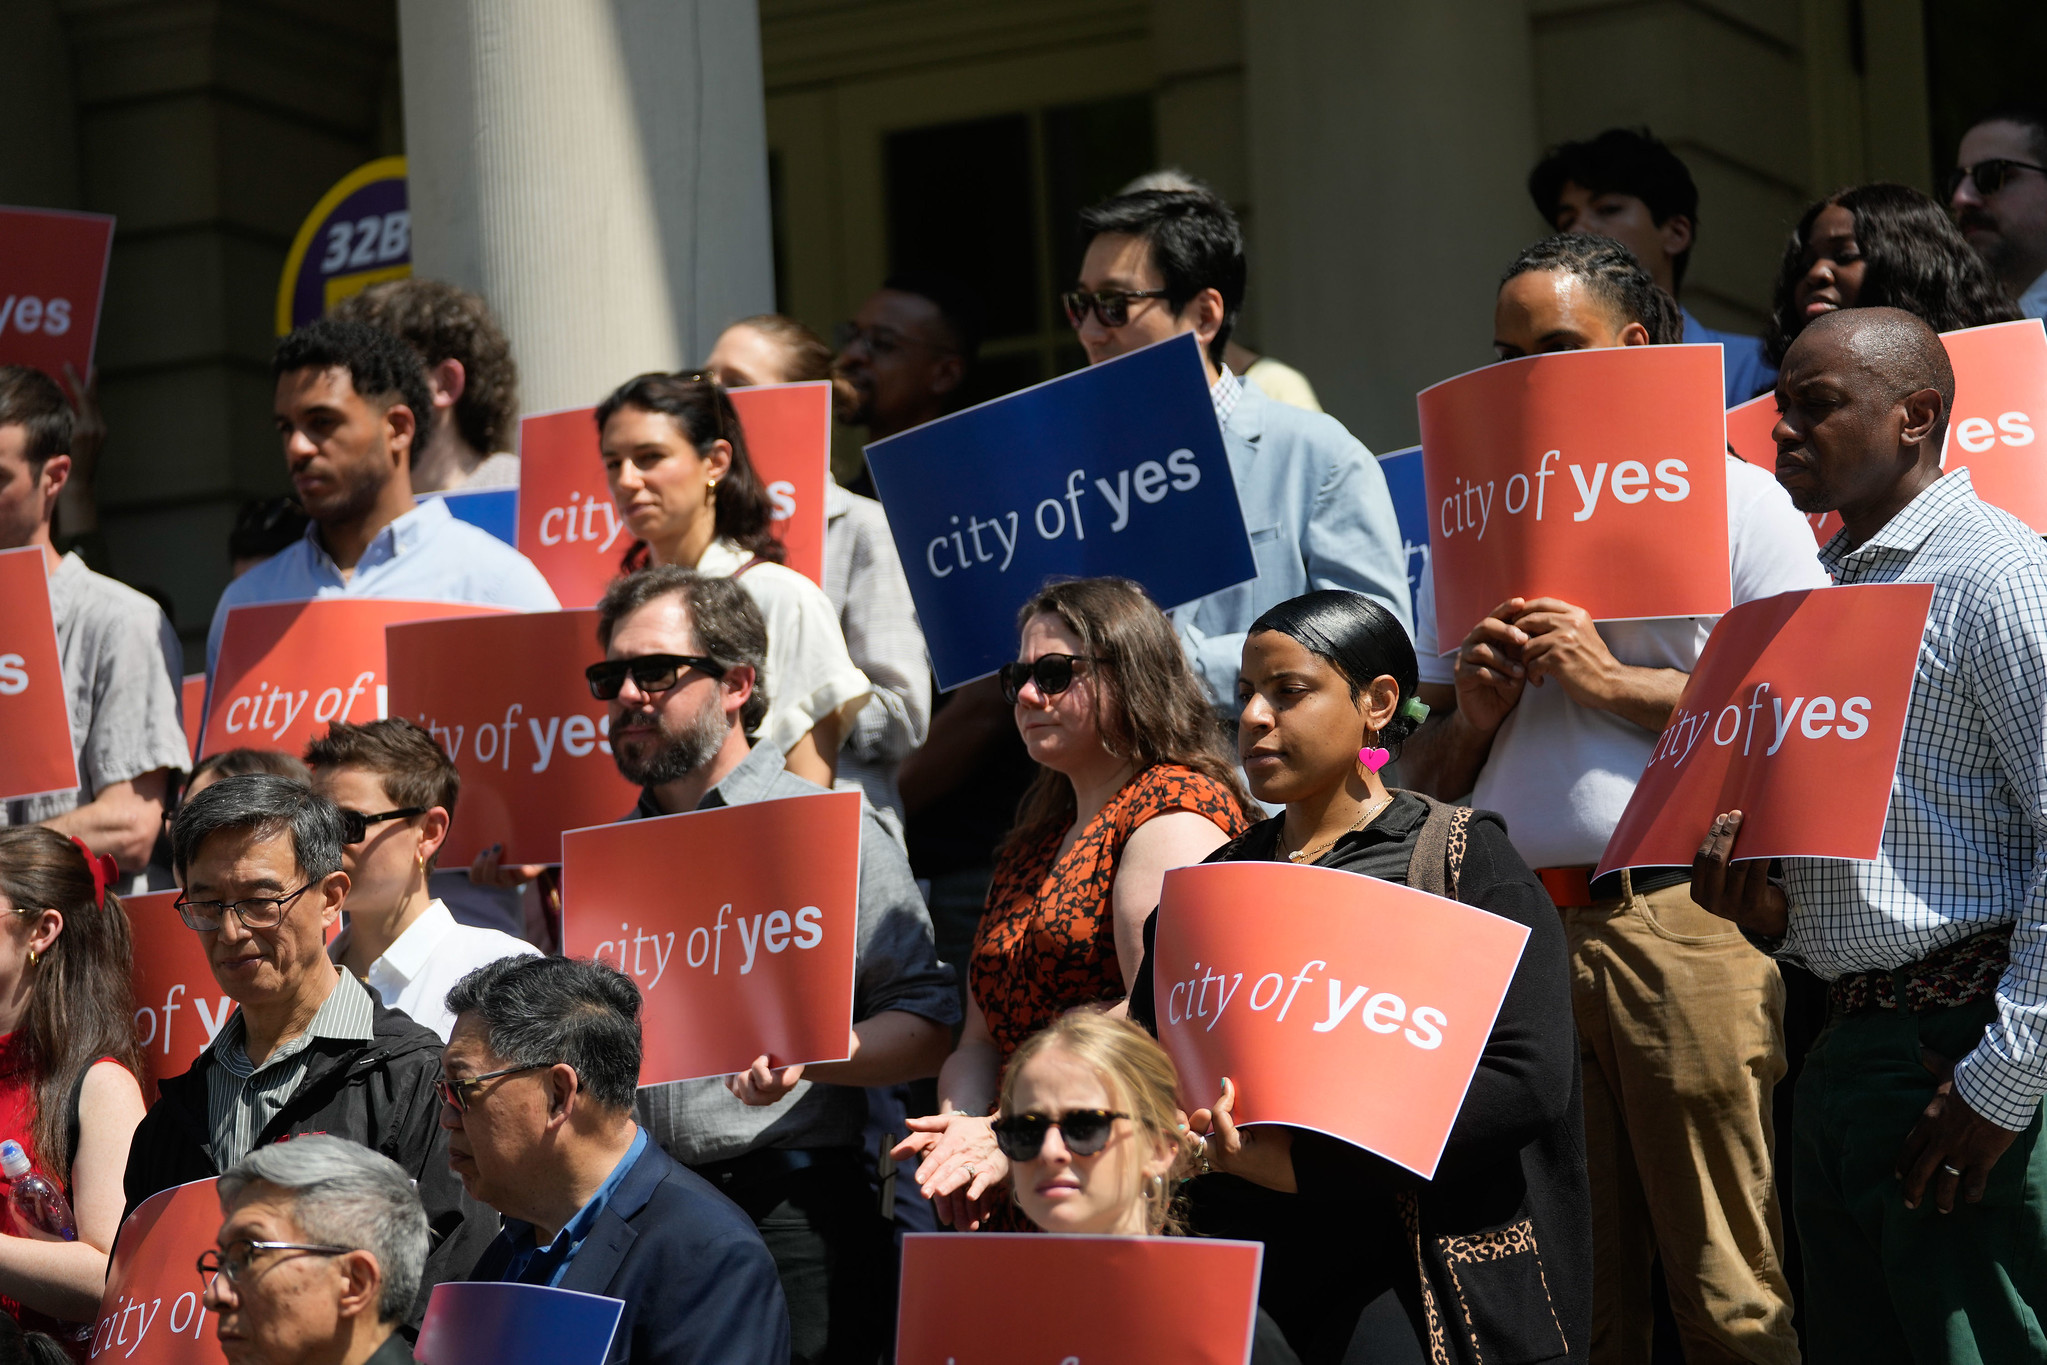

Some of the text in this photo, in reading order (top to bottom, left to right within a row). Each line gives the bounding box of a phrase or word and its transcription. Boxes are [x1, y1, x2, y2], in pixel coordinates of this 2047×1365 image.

[1939, 411, 2035, 468] es
[539, 491, 624, 554] city
[926, 448, 1201, 578] city of yes
[1441, 449, 1691, 541] city of yes
[225, 681, 309, 741] city
[313, 671, 376, 725] of
[474, 703, 523, 771] of
[1647, 682, 1872, 769] city of yes
[686, 903, 732, 975] of
[736, 905, 823, 975] yes
[134, 983, 186, 1055] of
[1169, 960, 1448, 1051] city of yes
[91, 1295, 162, 1359] city
